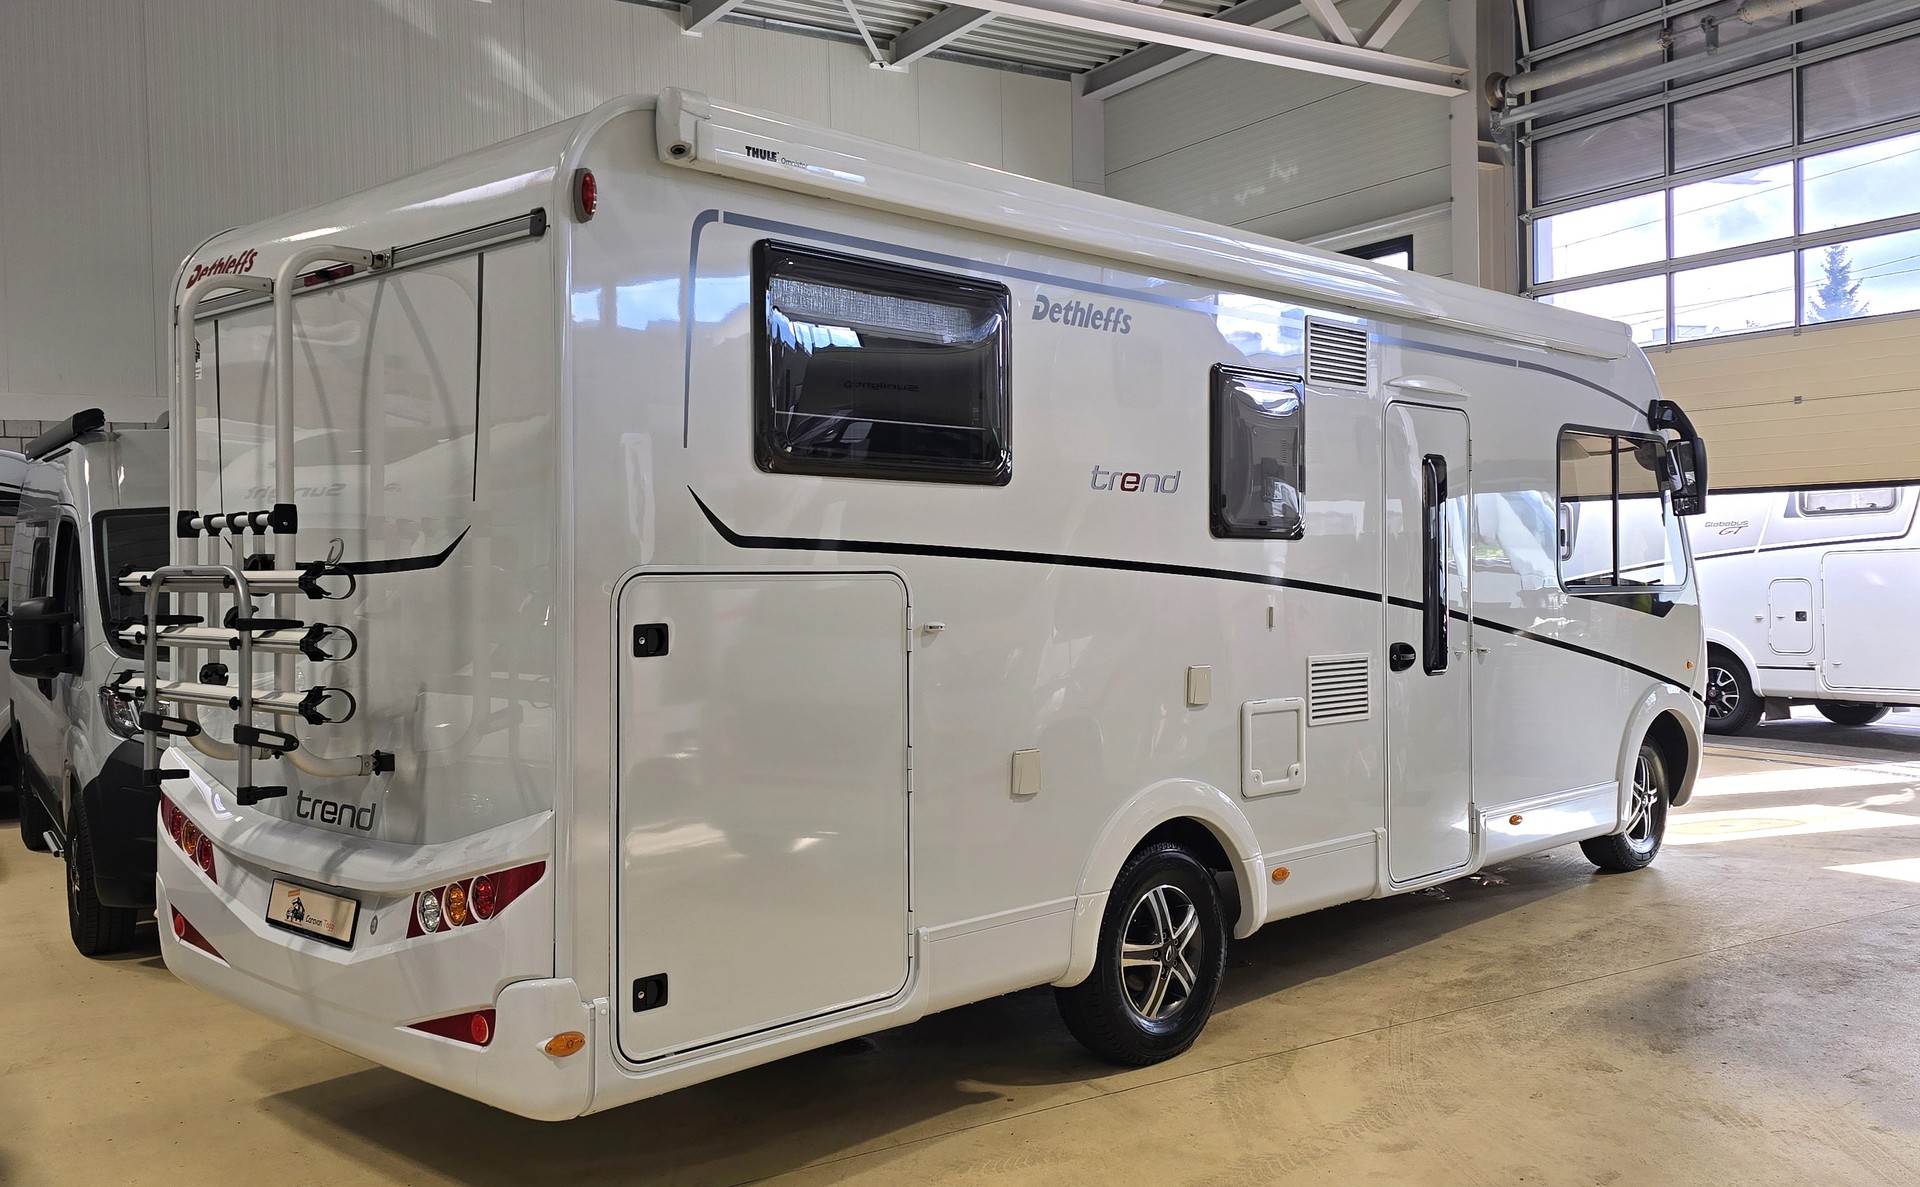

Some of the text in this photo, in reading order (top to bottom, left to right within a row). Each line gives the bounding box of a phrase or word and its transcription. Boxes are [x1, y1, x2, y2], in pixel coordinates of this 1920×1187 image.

[745, 145, 777, 162] THULE
[186, 248, 258, 289] Dethleffs
[1032, 294, 1132, 334] Dethleffs
[1091, 465, 1182, 493] trend
[296, 790, 376, 831] trend
